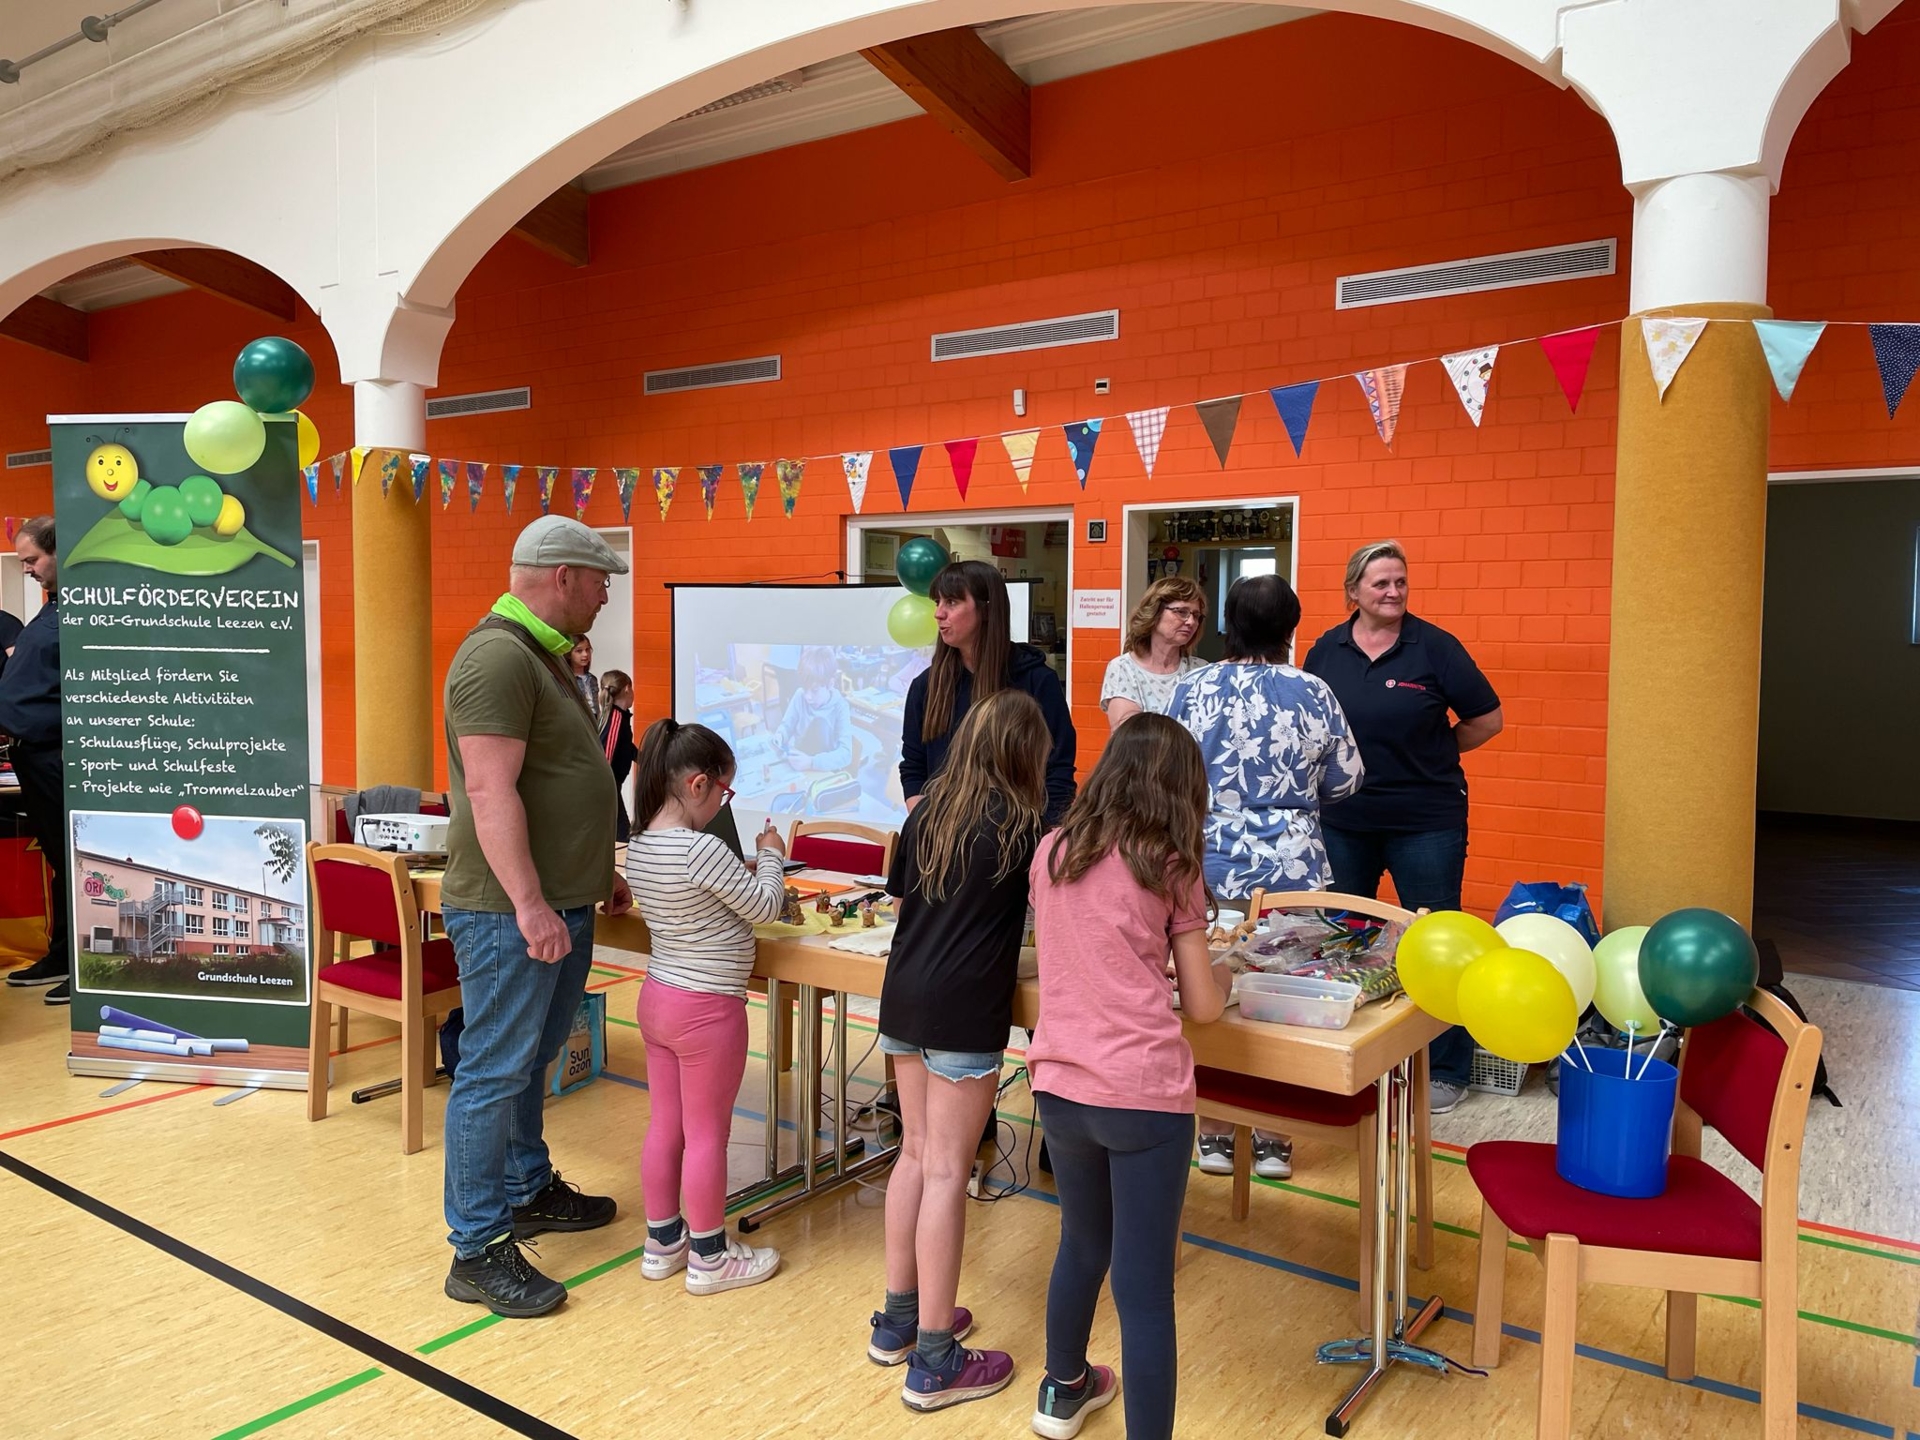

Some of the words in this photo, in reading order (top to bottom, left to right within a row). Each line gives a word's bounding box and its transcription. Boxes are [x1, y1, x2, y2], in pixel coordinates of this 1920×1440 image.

[61, 584, 298, 609] SCHULFÖRDERVEREIN
[63, 614, 83, 625] der
[90, 614, 211, 627] ORI-Grundschule
[217, 617, 264, 628] Leezen
[270, 617, 292, 629] e.V.
[65, 669, 84, 680] Als
[91, 668, 151, 685] Mitglied
[157, 667, 213, 684] fördern
[219, 670, 239, 682] Sie
[66, 691, 168, 703] verschiedenste
[173, 692, 254, 704] Aktivitäten
[67, 716, 83, 725] an
[89, 717, 142, 726] unserer
[148, 715, 194, 727] Schule:
[80, 734, 181, 753] Schulausflüge,
[187, 737, 286, 757] Schulprojekte
[81, 758, 122, 777] Sport-
[129, 759, 158, 771] und
[163, 758, 236, 775] Schulfeste
[82, 780, 143, 797] Projekte
[149, 783, 172, 793] wie
[85, 881, 102, 894] ORI
[198, 972, 257, 983] Grundschule
[260, 975, 292, 985] Leezen
